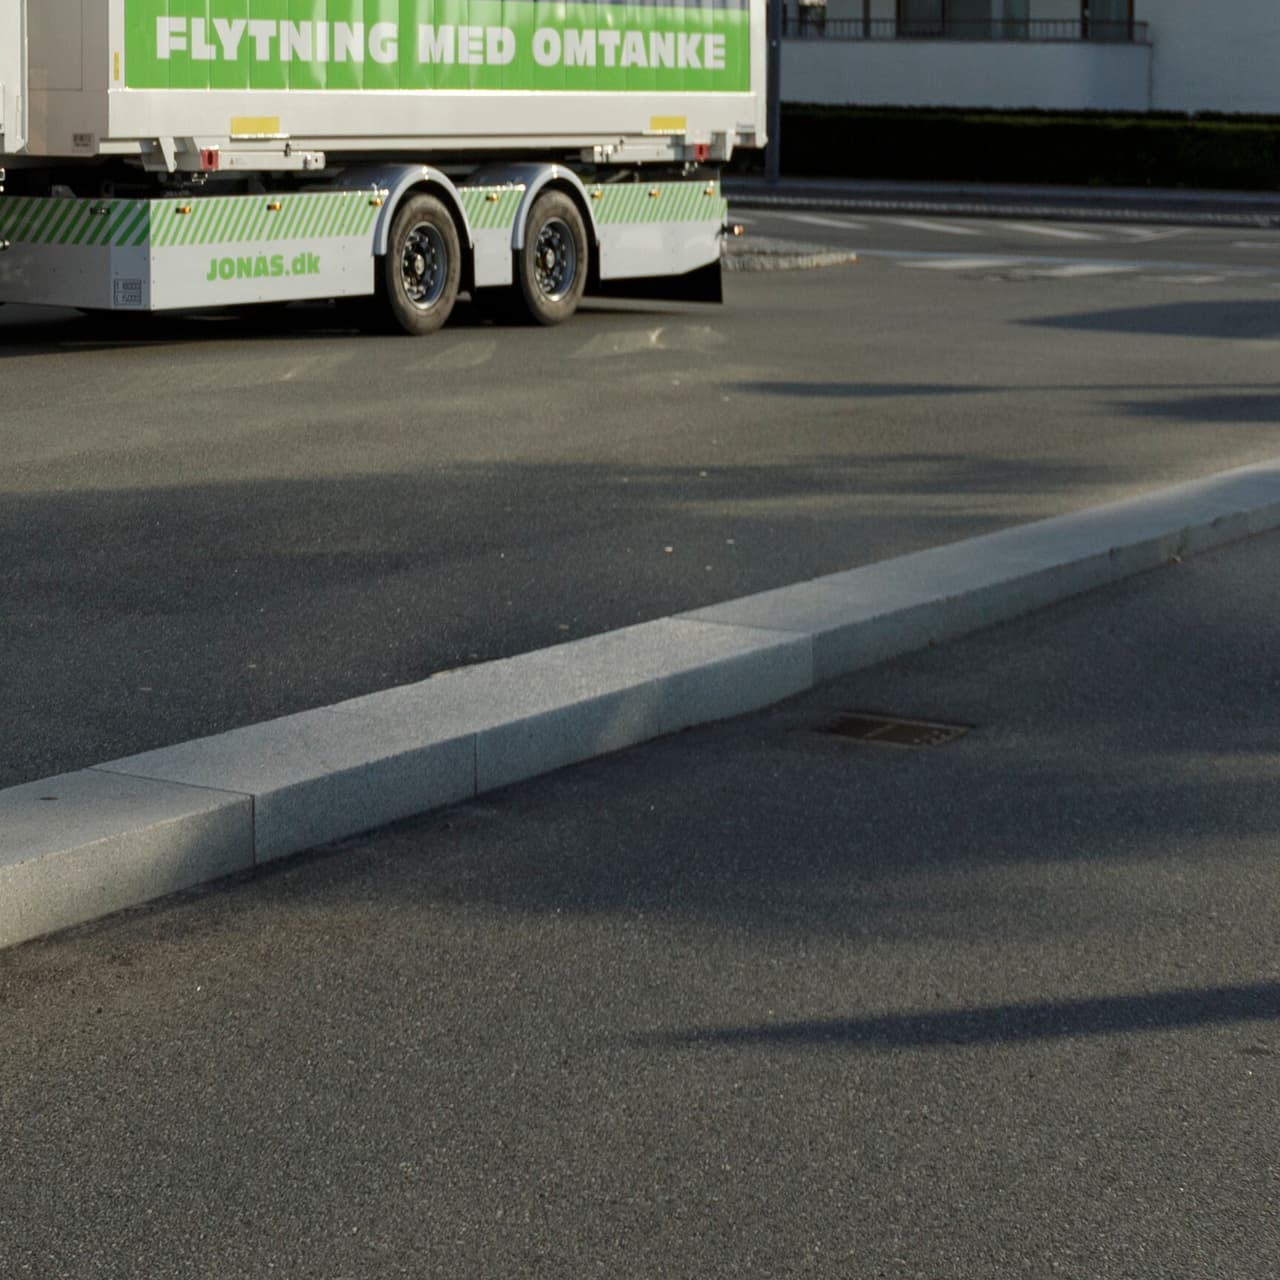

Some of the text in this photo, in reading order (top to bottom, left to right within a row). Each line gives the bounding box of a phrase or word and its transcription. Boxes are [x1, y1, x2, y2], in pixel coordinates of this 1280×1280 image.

[155, 16, 726, 71] FLYTNING MED OMTANKE
[206, 251, 321, 282] JONAS.dk
